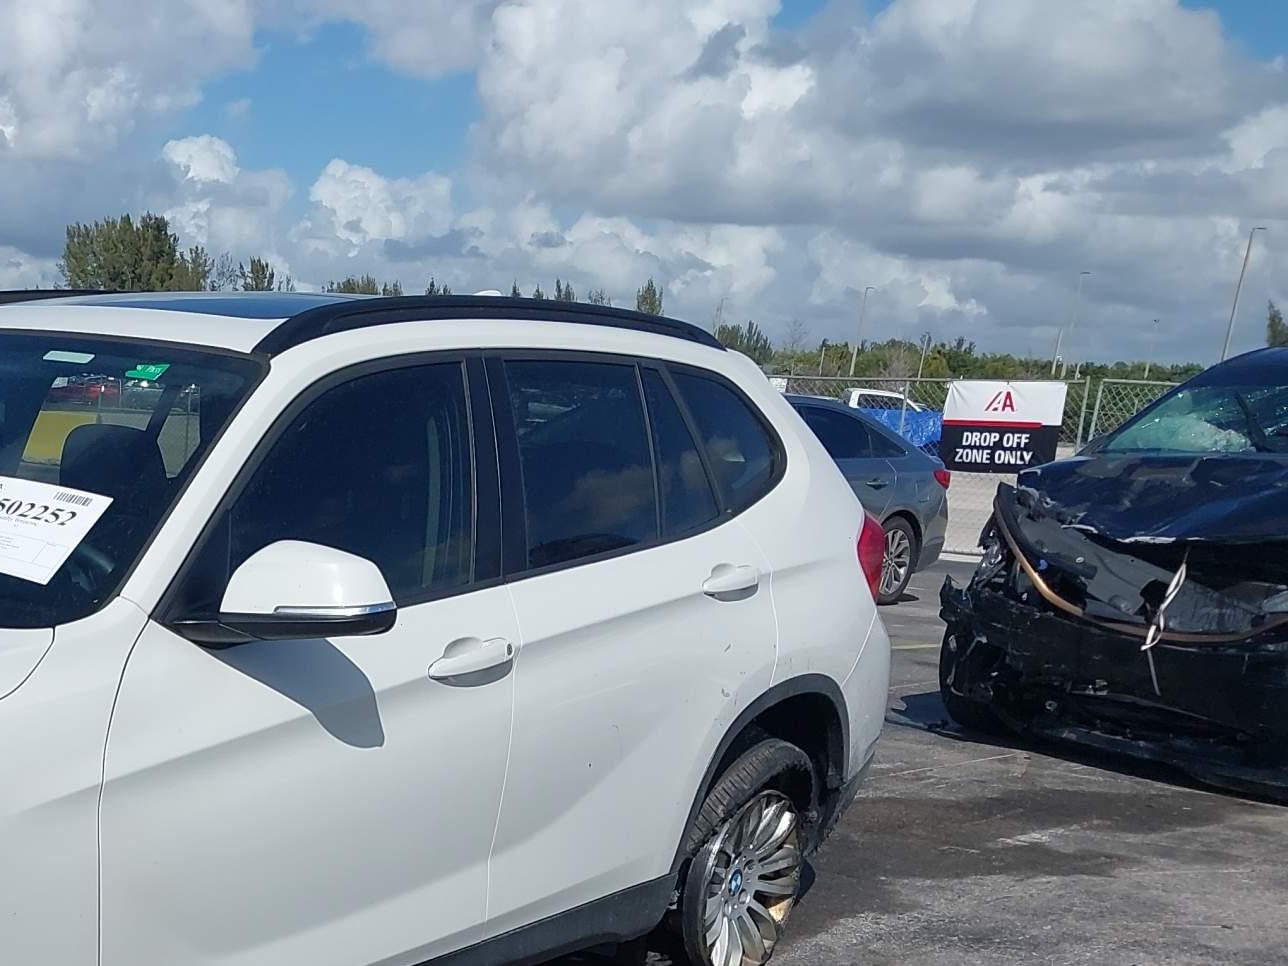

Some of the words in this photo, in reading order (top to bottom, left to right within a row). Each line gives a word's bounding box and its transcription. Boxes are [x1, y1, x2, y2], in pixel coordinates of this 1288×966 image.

[962, 431, 1000, 446] DROP
[1003, 433, 1030, 448] OFF
[954, 448, 991, 463] ZONE
[994, 450, 1033, 464] ONLY
